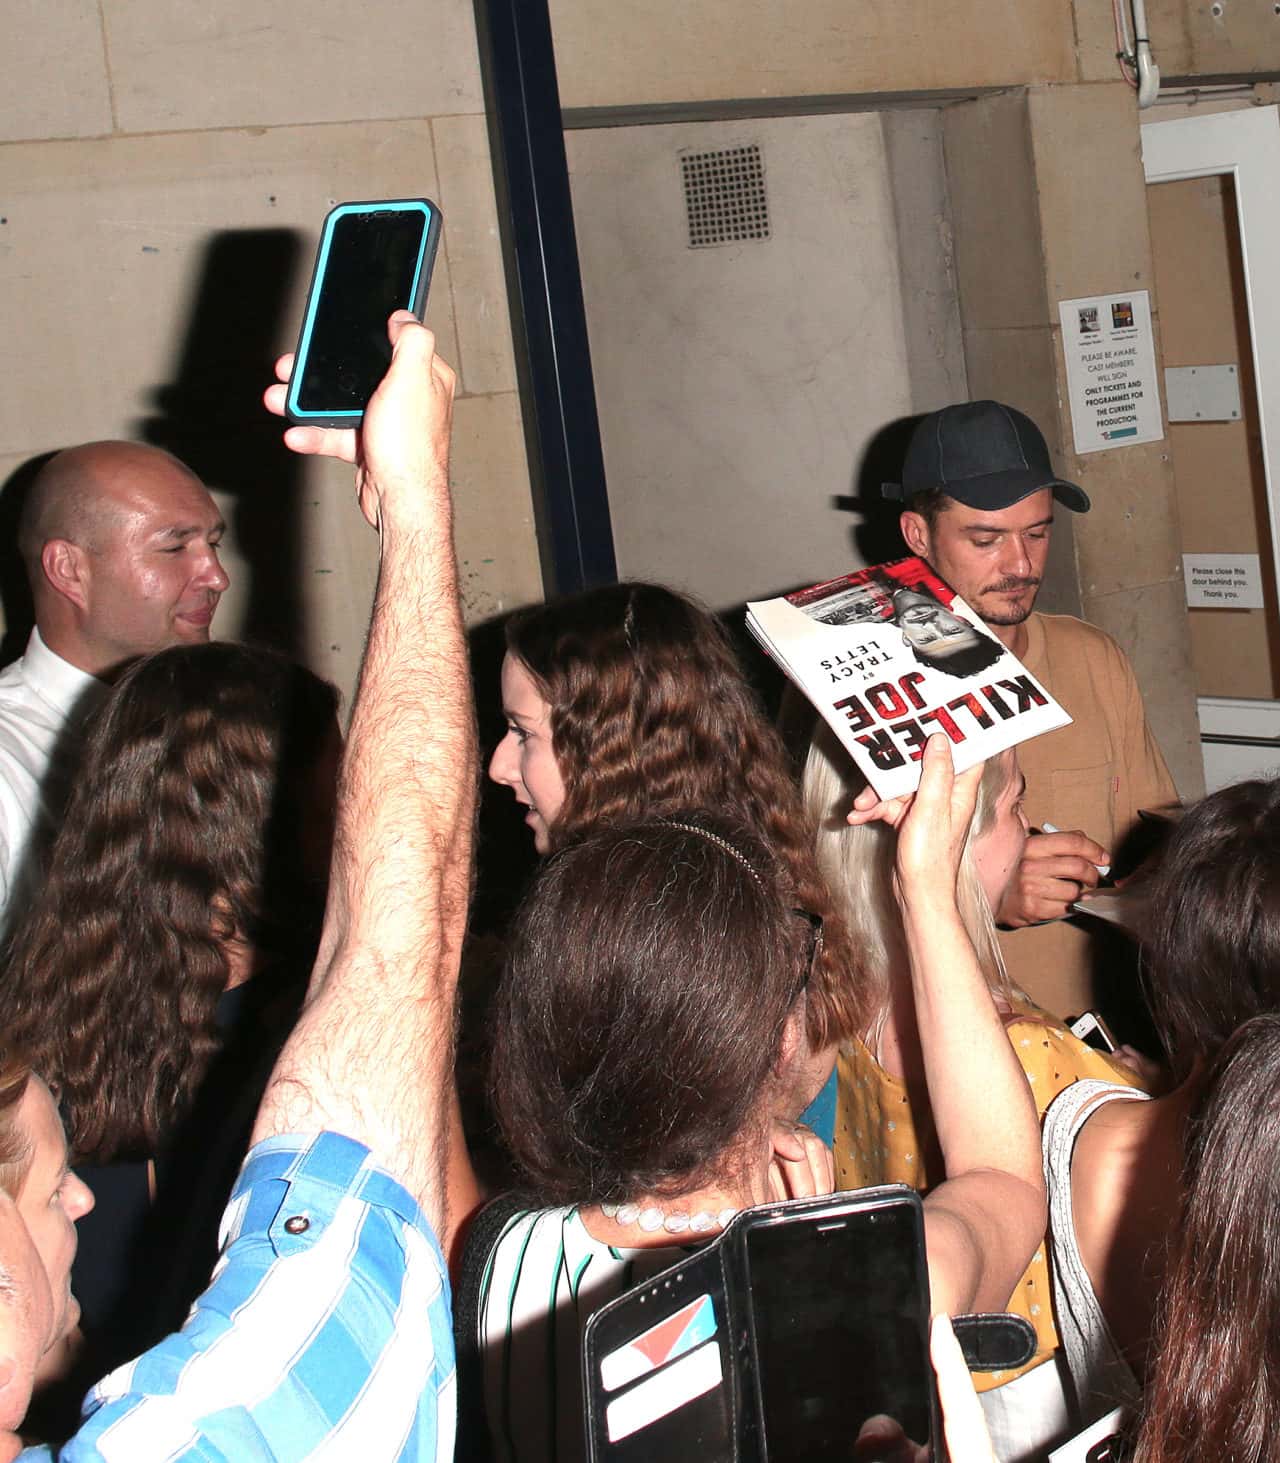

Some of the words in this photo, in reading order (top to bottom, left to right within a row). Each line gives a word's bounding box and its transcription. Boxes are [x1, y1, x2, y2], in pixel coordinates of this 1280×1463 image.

[1081, 352, 1103, 362] PLEASE
[1088, 363, 1103, 372] CAST
[1105, 359, 1135, 369] MEMBERS
[1085, 386, 1101, 395] ONLY
[1103, 382, 1126, 392] TICKETS
[1128, 380, 1142, 388] AND
[1086, 393, 1130, 406] PROGRAMMES
[1097, 408, 1107, 416] THE
[1109, 403, 1136, 414] CURRENT
[1192, 567, 1213, 575] Please
[1215, 567, 1232, 575] close
[1234, 567, 1246, 575] this
[1208, 578, 1232, 586] behind
[1203, 590, 1222, 598] Thank
[820, 640, 880, 670] LETTS
[830, 652, 893, 683] TRACY
[862, 672, 875, 681] BY
[833, 672, 927, 732] JOE
[854, 675, 1049, 770] KILLER
